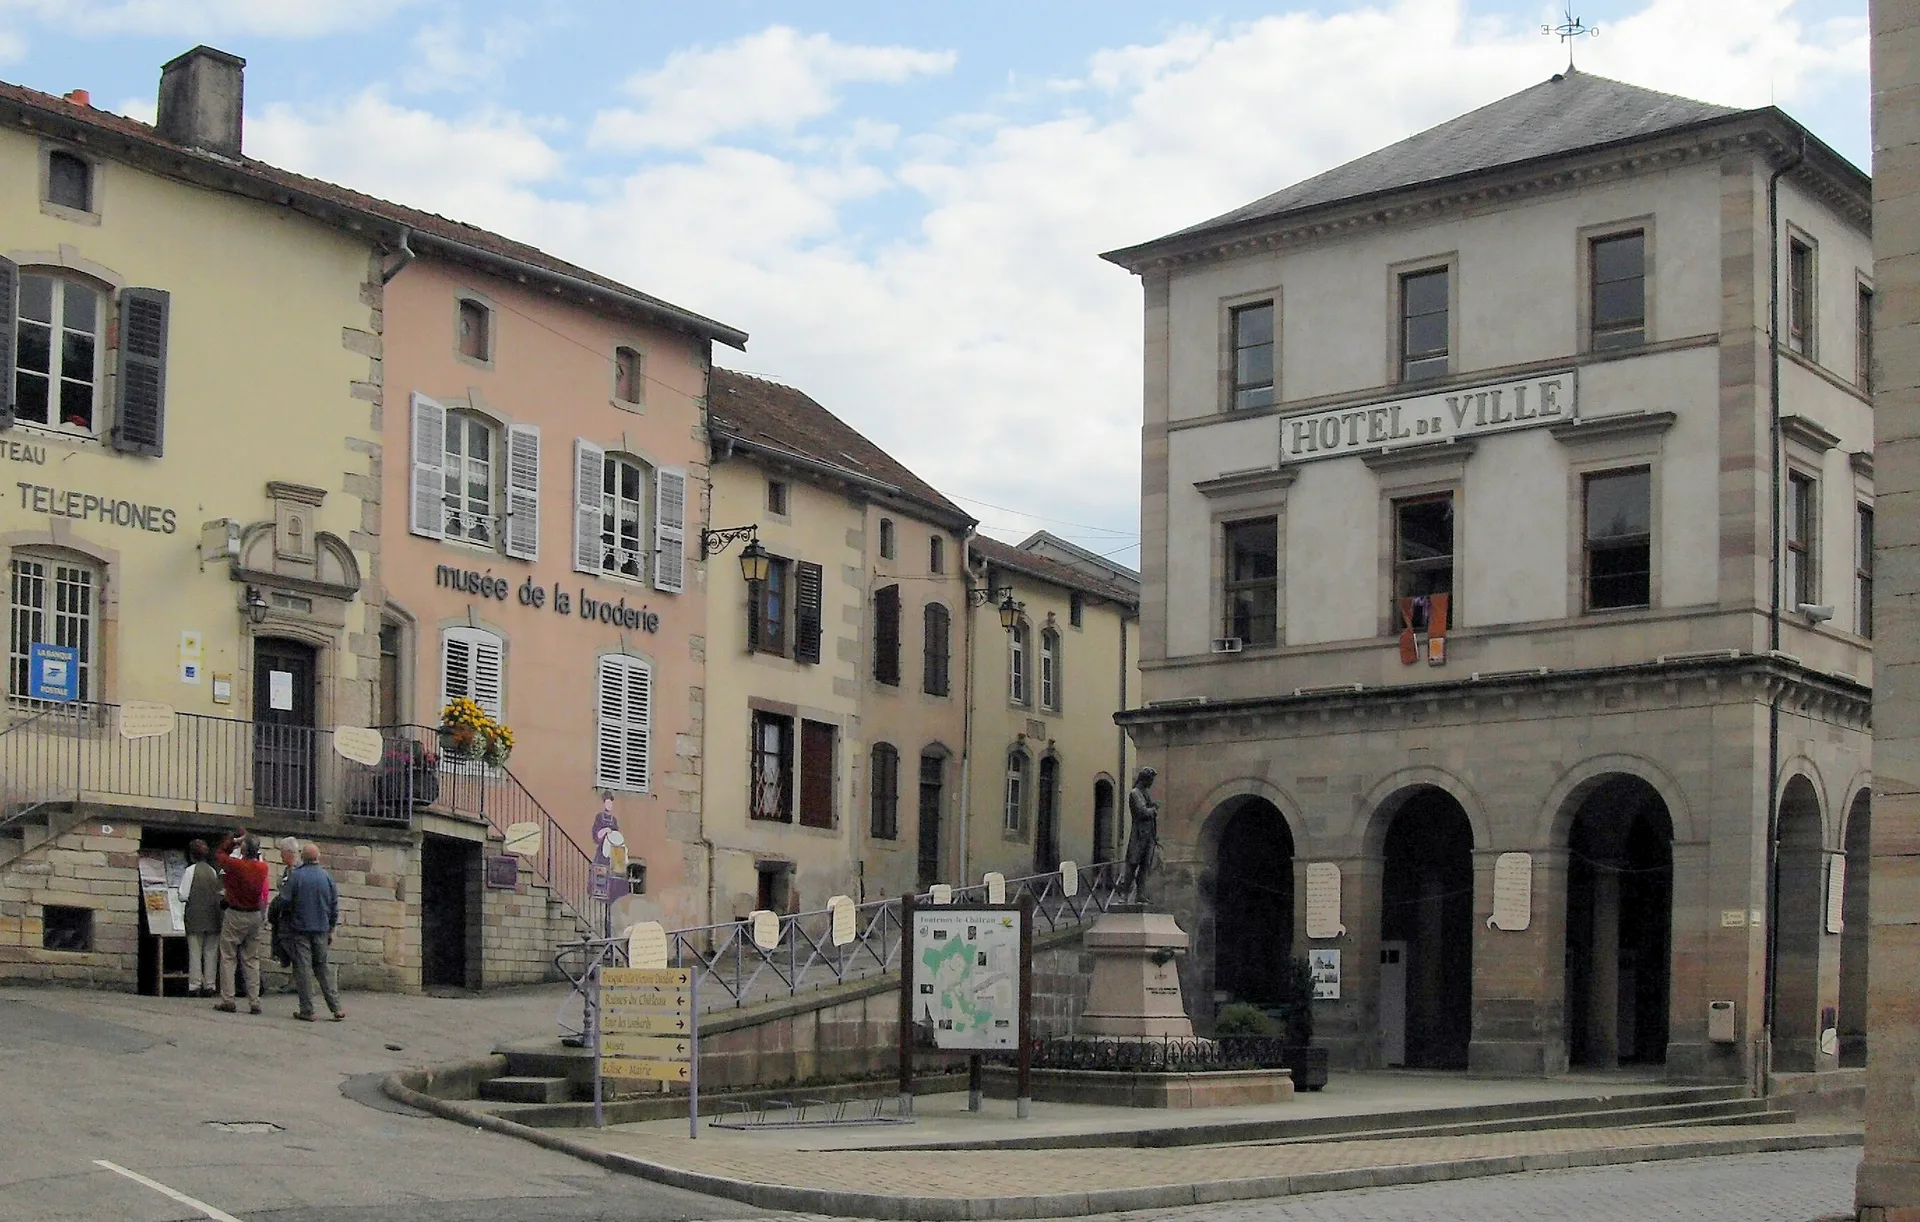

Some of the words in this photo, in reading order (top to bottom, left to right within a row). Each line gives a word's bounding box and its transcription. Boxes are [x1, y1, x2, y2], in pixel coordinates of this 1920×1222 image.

[1291, 406, 1410, 455] HOTEL
[1416, 416, 1442, 436] DE
[1445, 379, 1563, 429] VILLE
[436, 563, 509, 601] musée
[518, 575, 545, 609] de
[553, 582, 572, 615] la
[580, 588, 660, 634] broderie
